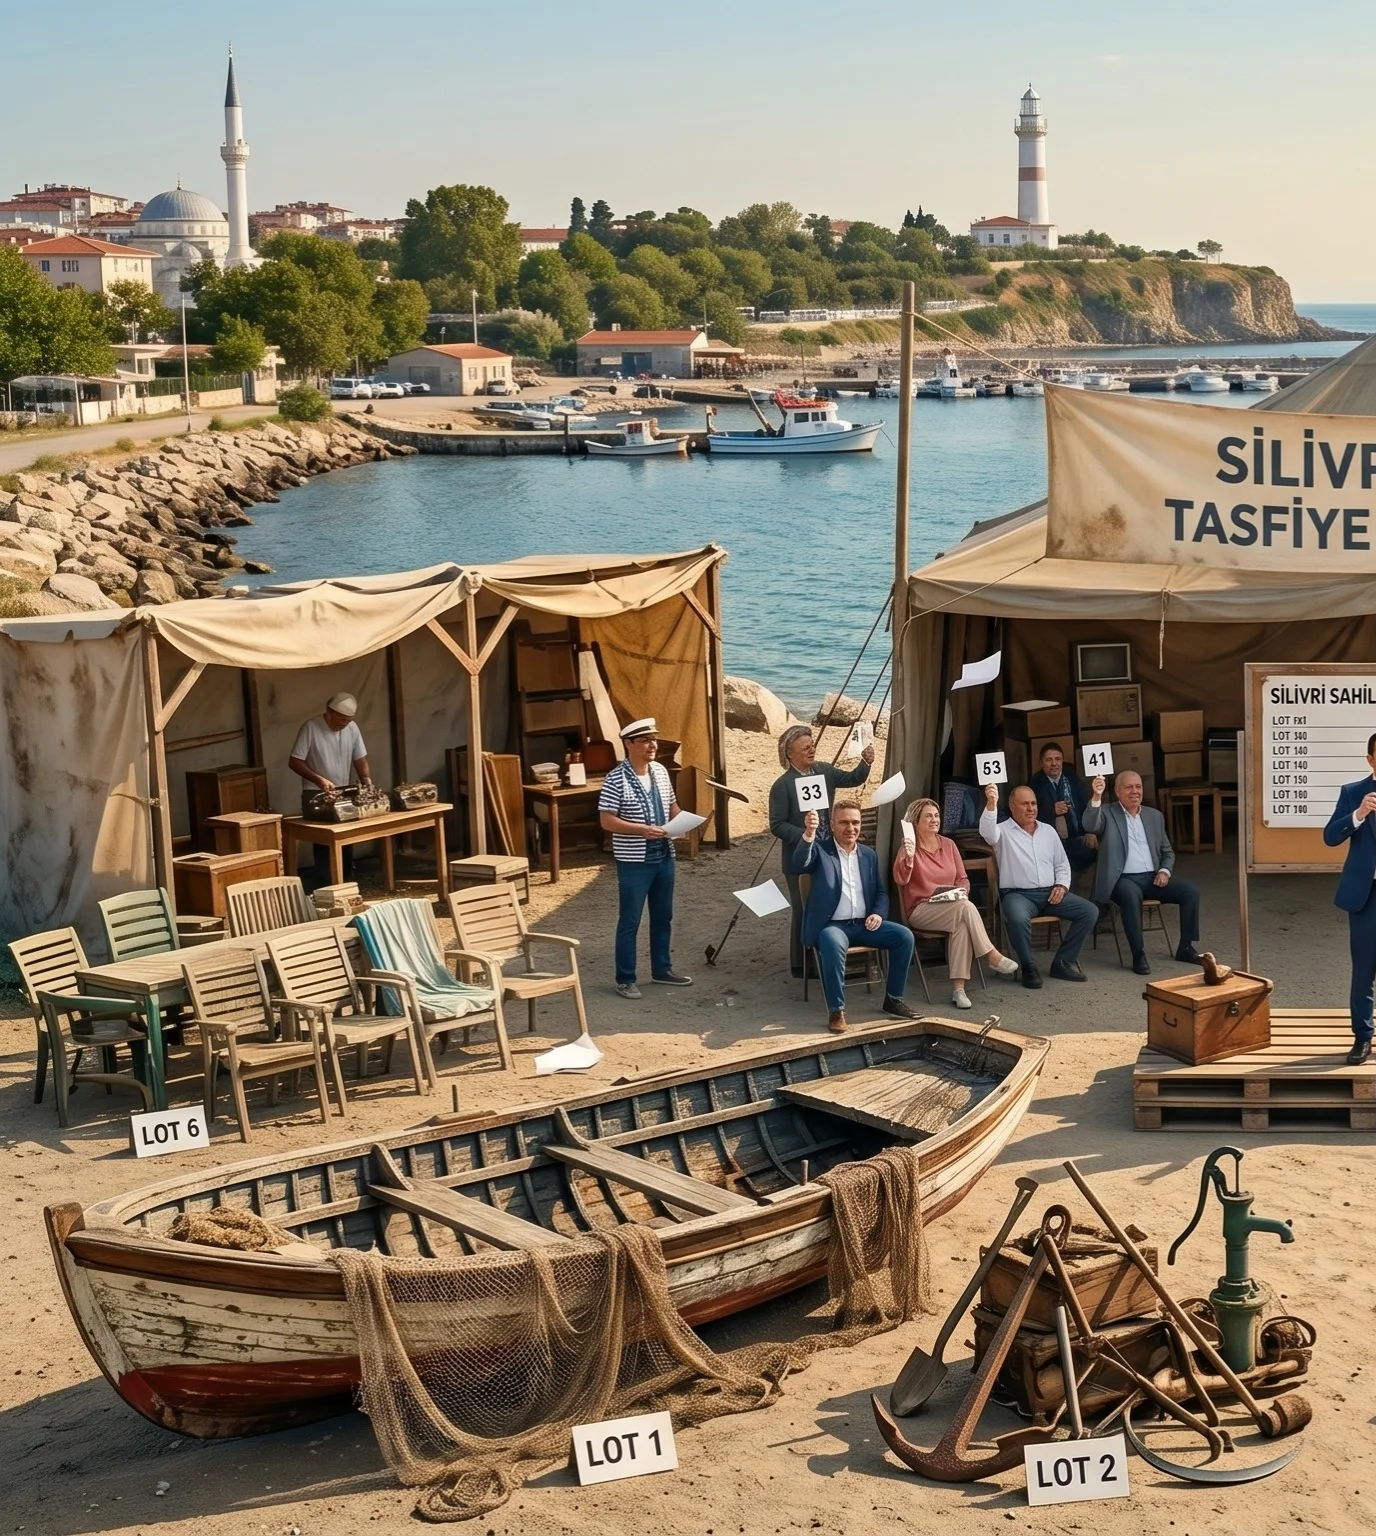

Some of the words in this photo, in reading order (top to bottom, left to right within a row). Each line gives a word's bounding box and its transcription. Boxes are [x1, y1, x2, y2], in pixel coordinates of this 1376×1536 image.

[1165, 496, 1371, 551] TASFİYE
[1270, 683, 1326, 705] SİLİVRİ
[1330, 683, 1376, 705] SAHİL
[1272, 716, 1291, 725] LOT
[1272, 731, 1291, 740] LOT
[1272, 746, 1291, 755] LOT
[1089, 751, 1106, 767] 41
[1272, 760, 1291, 770] LOT
[983, 760, 1002, 776] 53
[1272, 775, 1291, 784] LOT
[802, 784, 822, 801] 33
[1272, 805, 1291, 814] LOT
[142, 1121, 180, 1145] LOT
[188, 1118, 200, 1137] 6
[586, 1433, 639, 1467] LOT
[648, 1429, 662, 1456] 1
[1036, 1456, 1091, 1488] LOT
[1099, 1453, 1118, 1483] 2
